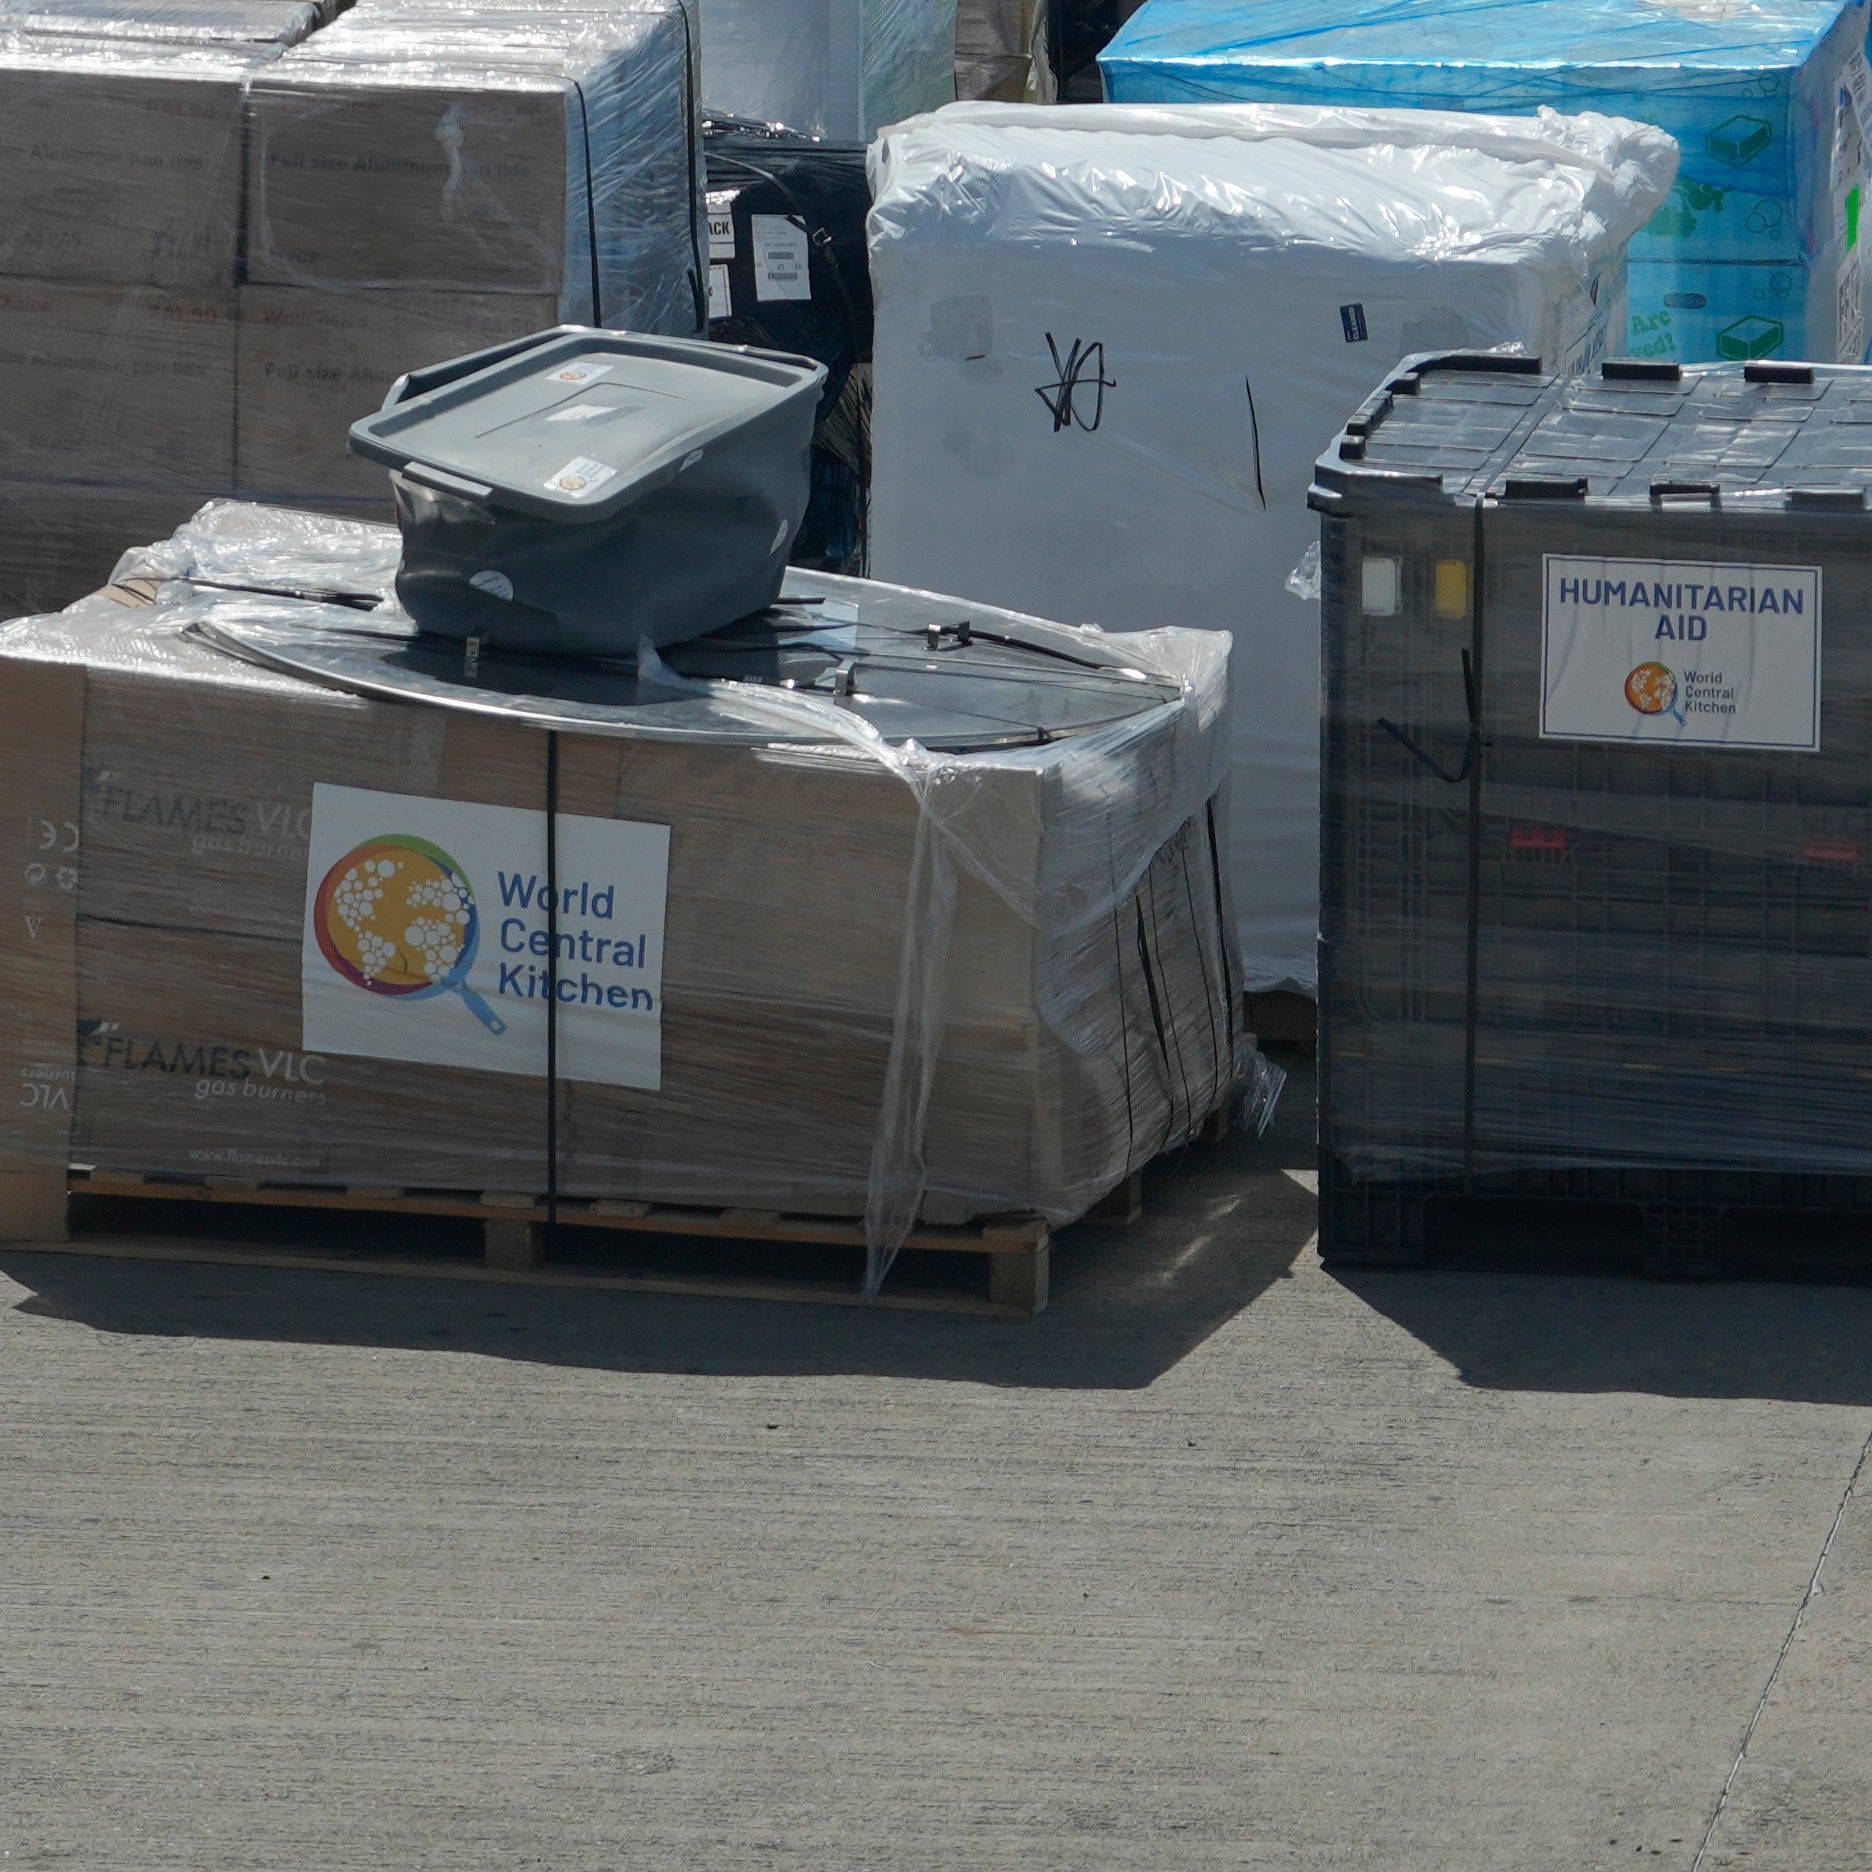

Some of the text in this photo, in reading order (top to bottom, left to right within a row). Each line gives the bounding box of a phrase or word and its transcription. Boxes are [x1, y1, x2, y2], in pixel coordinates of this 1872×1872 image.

[1559, 576, 1804, 615] HUMANITARIAN
[1654, 614, 1709, 642] AID
[1683, 670, 1723, 685] World
[1684, 685, 1735, 700] Central
[1684, 699, 1737, 715] Kitchen
[498, 869, 615, 922] World
[499, 919, 647, 970] Central
[499, 962, 655, 1013] Kitchen
[105, 1036, 329, 1086] FLAMES VLC
[194, 1078, 329, 1106] gas burners
